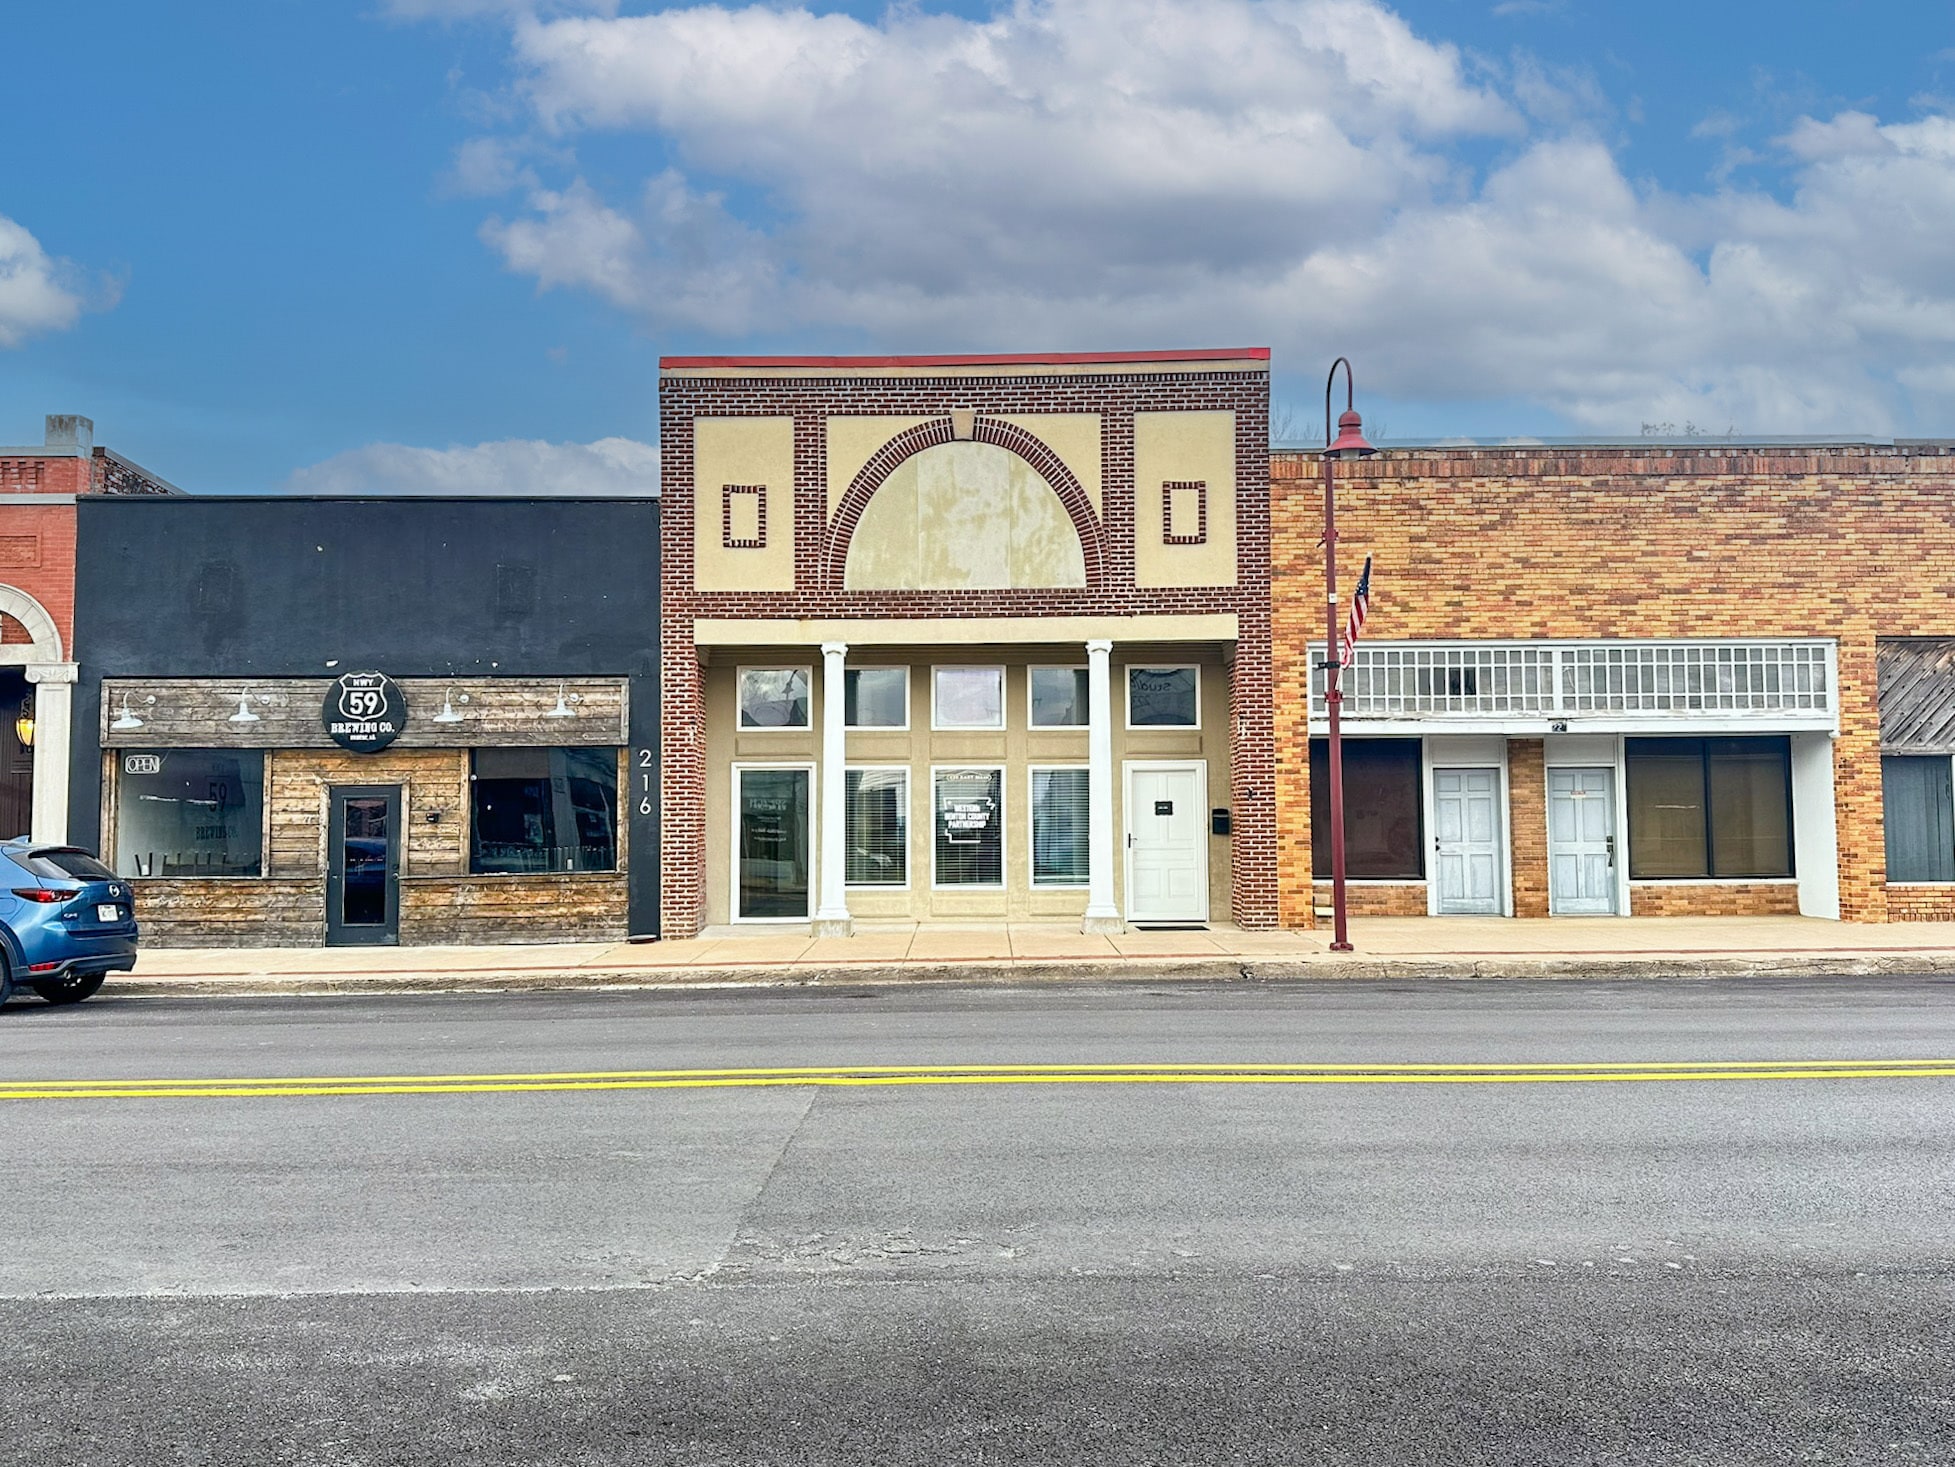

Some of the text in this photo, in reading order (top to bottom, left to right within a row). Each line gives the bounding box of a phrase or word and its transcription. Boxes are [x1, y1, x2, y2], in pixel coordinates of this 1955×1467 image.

[353, 679, 374, 687] HWY
[349, 692, 378, 714] 59
[331, 722, 395, 733] BREWING CO.
[127, 757, 158, 772] OPEN
[639, 749, 652, 815] 216
[209, 782, 227, 812] 59
